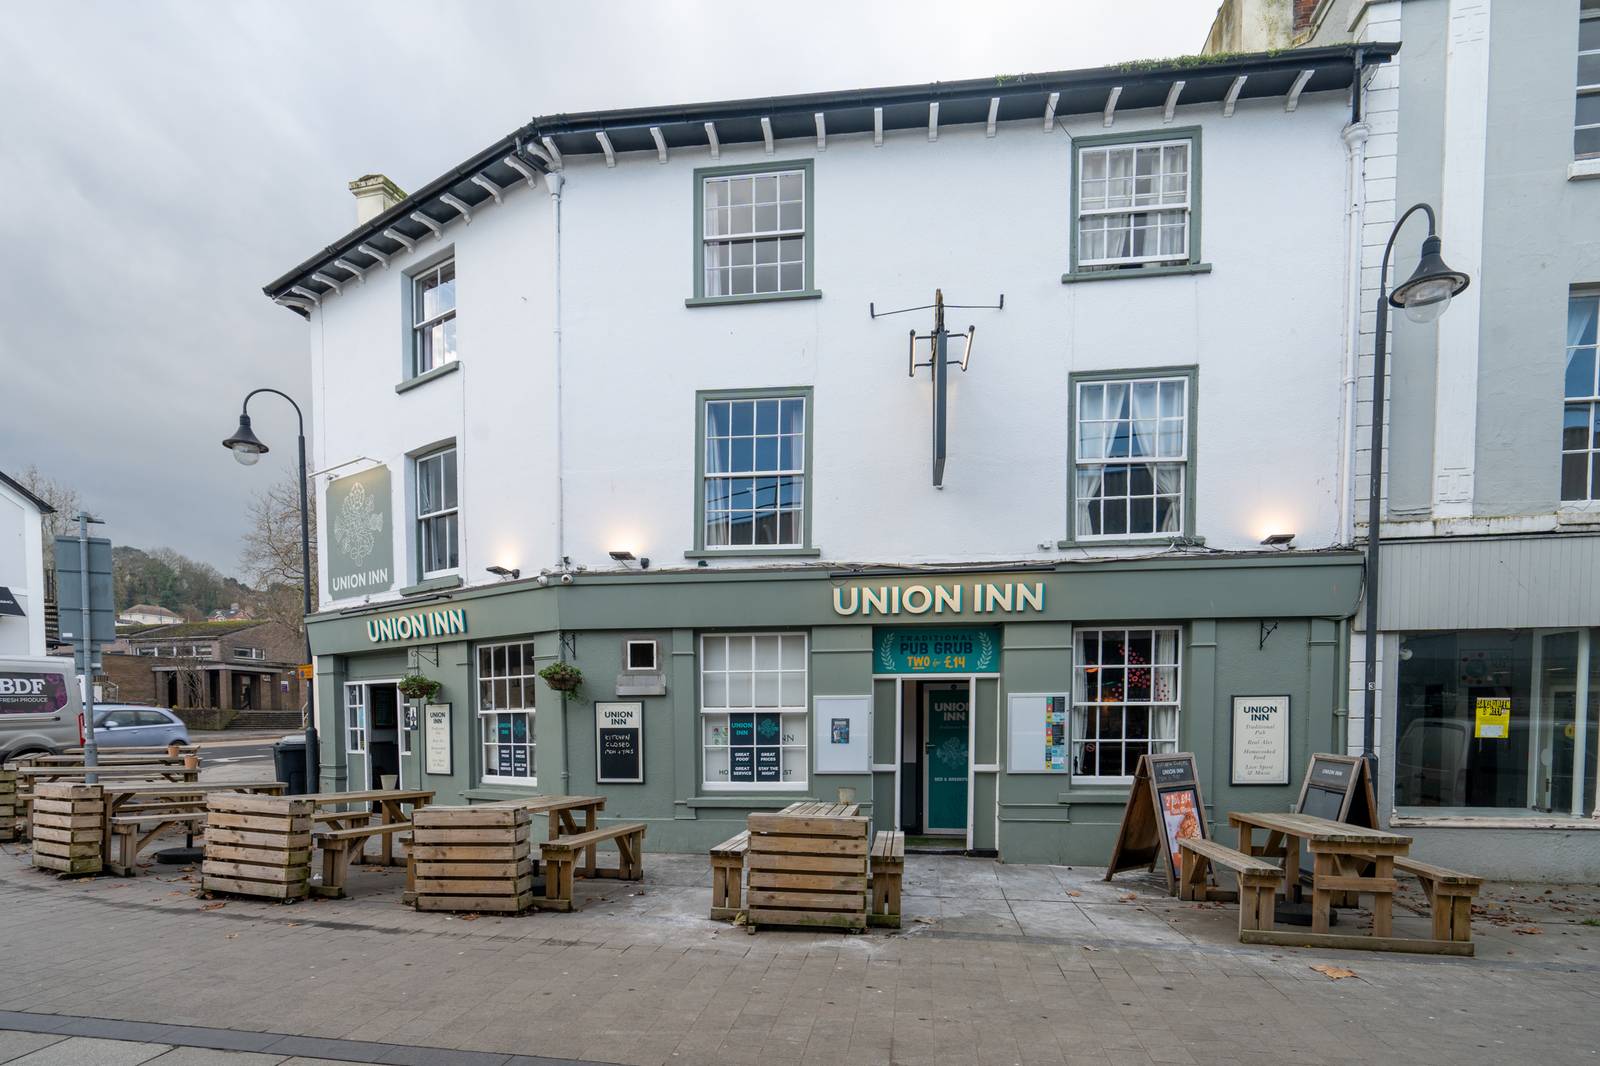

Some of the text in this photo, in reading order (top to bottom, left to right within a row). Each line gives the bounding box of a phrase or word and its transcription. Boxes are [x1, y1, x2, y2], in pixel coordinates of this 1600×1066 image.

[333, 568, 388, 592] UNION INN
[833, 582, 1046, 616] UNION INN
[367, 608, 467, 642] UNION INN
[900, 634, 974, 642] TRADITIONAL
[900, 641, 973, 655] PUB GRUB
[907, 655, 930, 669] TWO
[944, 655, 966, 668] £14
[0, 678, 46, 694] BDF
[943, 712, 966, 721] INN
